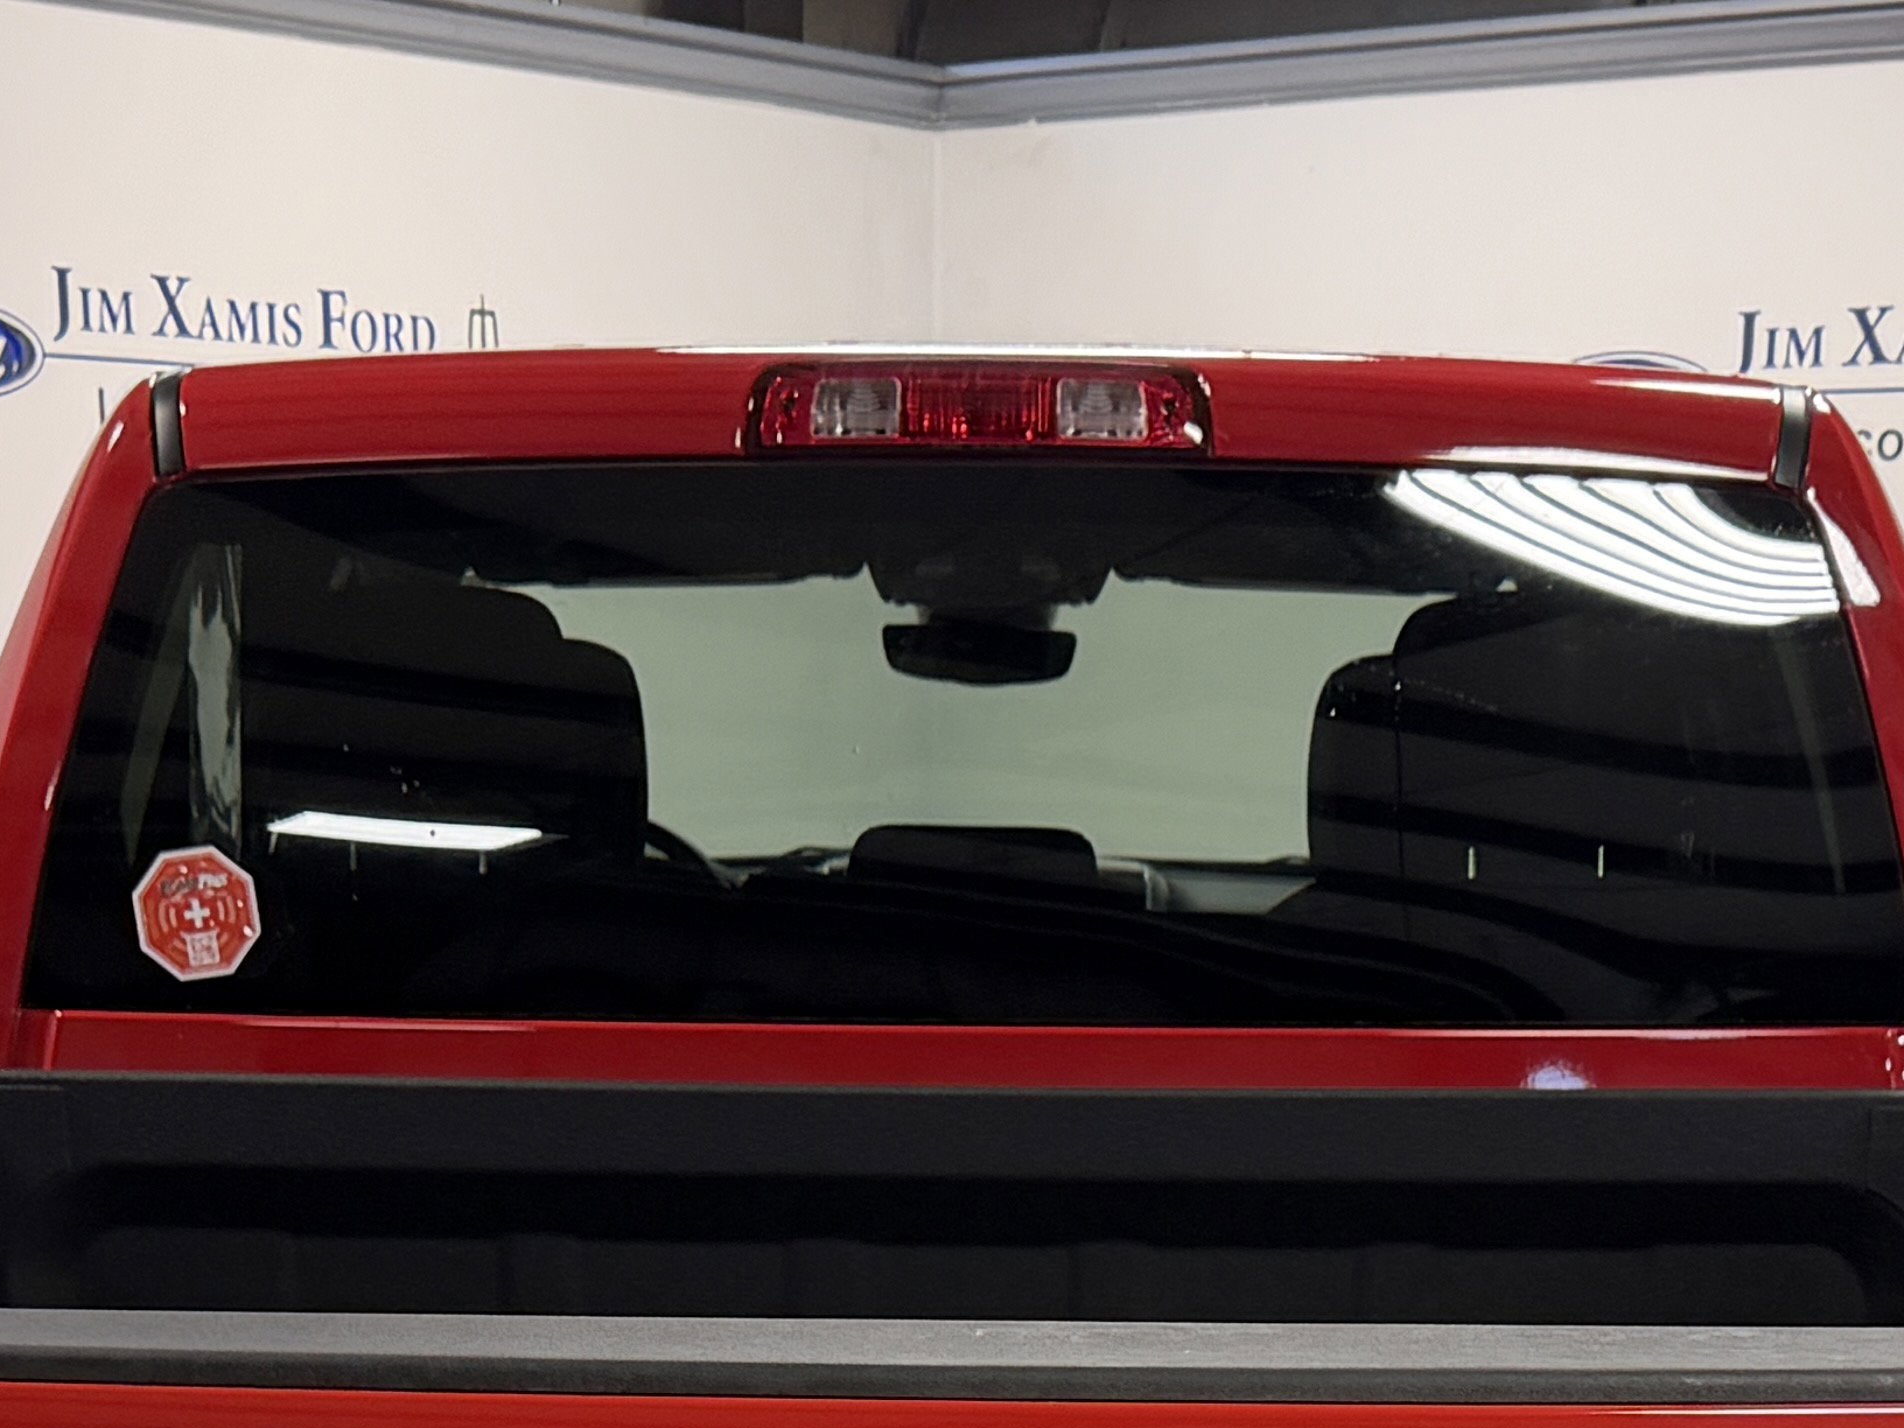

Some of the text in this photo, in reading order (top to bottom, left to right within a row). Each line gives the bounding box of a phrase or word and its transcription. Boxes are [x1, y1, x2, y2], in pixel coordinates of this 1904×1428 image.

[51, 266, 436, 353] JIM XAMIS FORD
[1739, 310, 1825, 374] JIM
